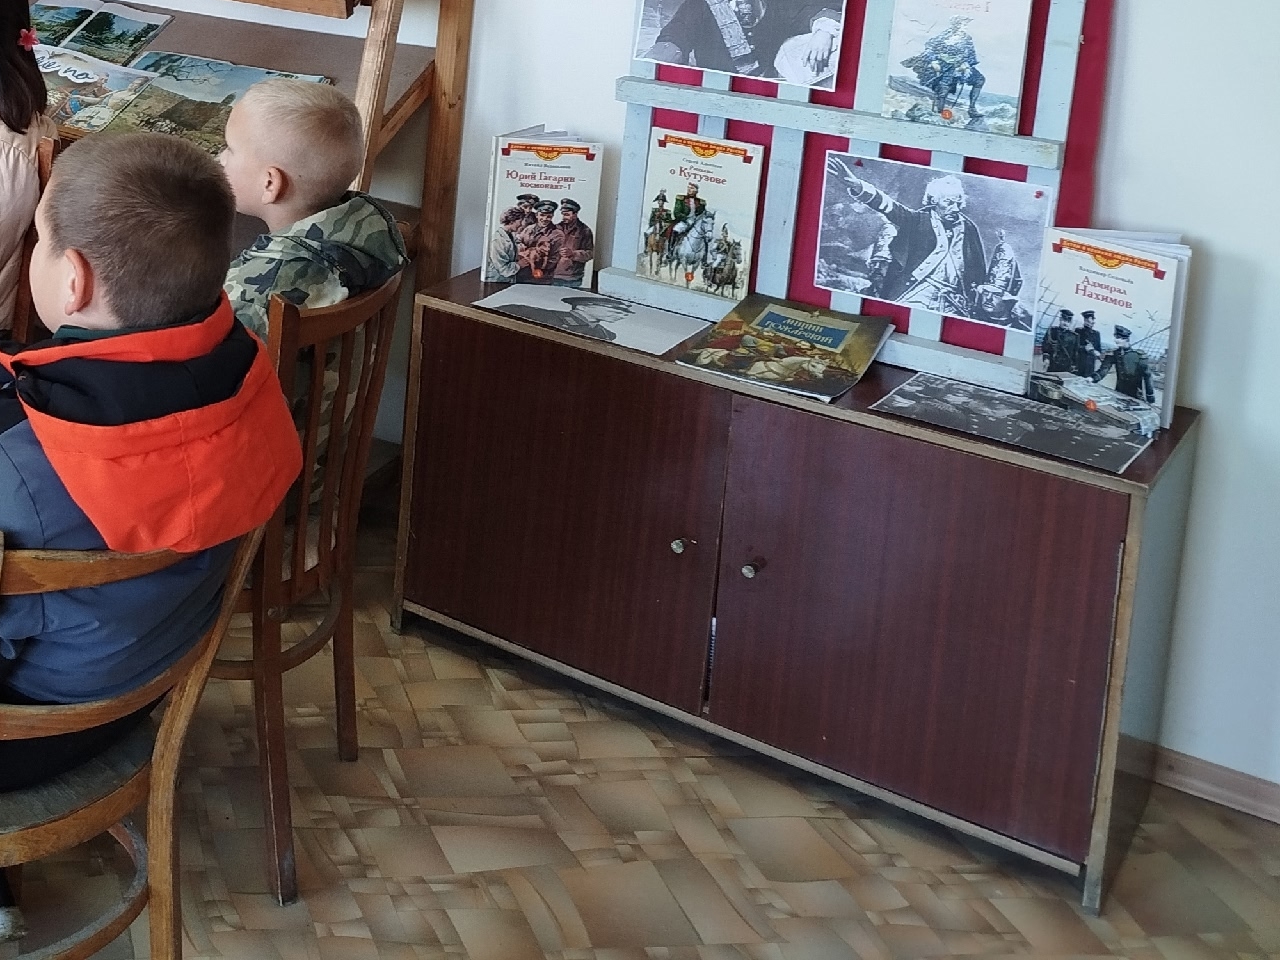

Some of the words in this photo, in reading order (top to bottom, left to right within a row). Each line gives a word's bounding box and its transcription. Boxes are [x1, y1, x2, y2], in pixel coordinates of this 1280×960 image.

[506, 170, 537, 182] Юрий
[539, 172, 576, 184] Гагарин
[679, 166, 727, 185] Кутузове
[520, 182, 571, 190] космонавт-1
[1081, 275, 1128, 296] Адмирал
[1074, 283, 1133, 309] Нахимов
[764, 320, 834, 344] ПОЖАРСКИЙ
[782, 318, 824, 333] МИНИН
